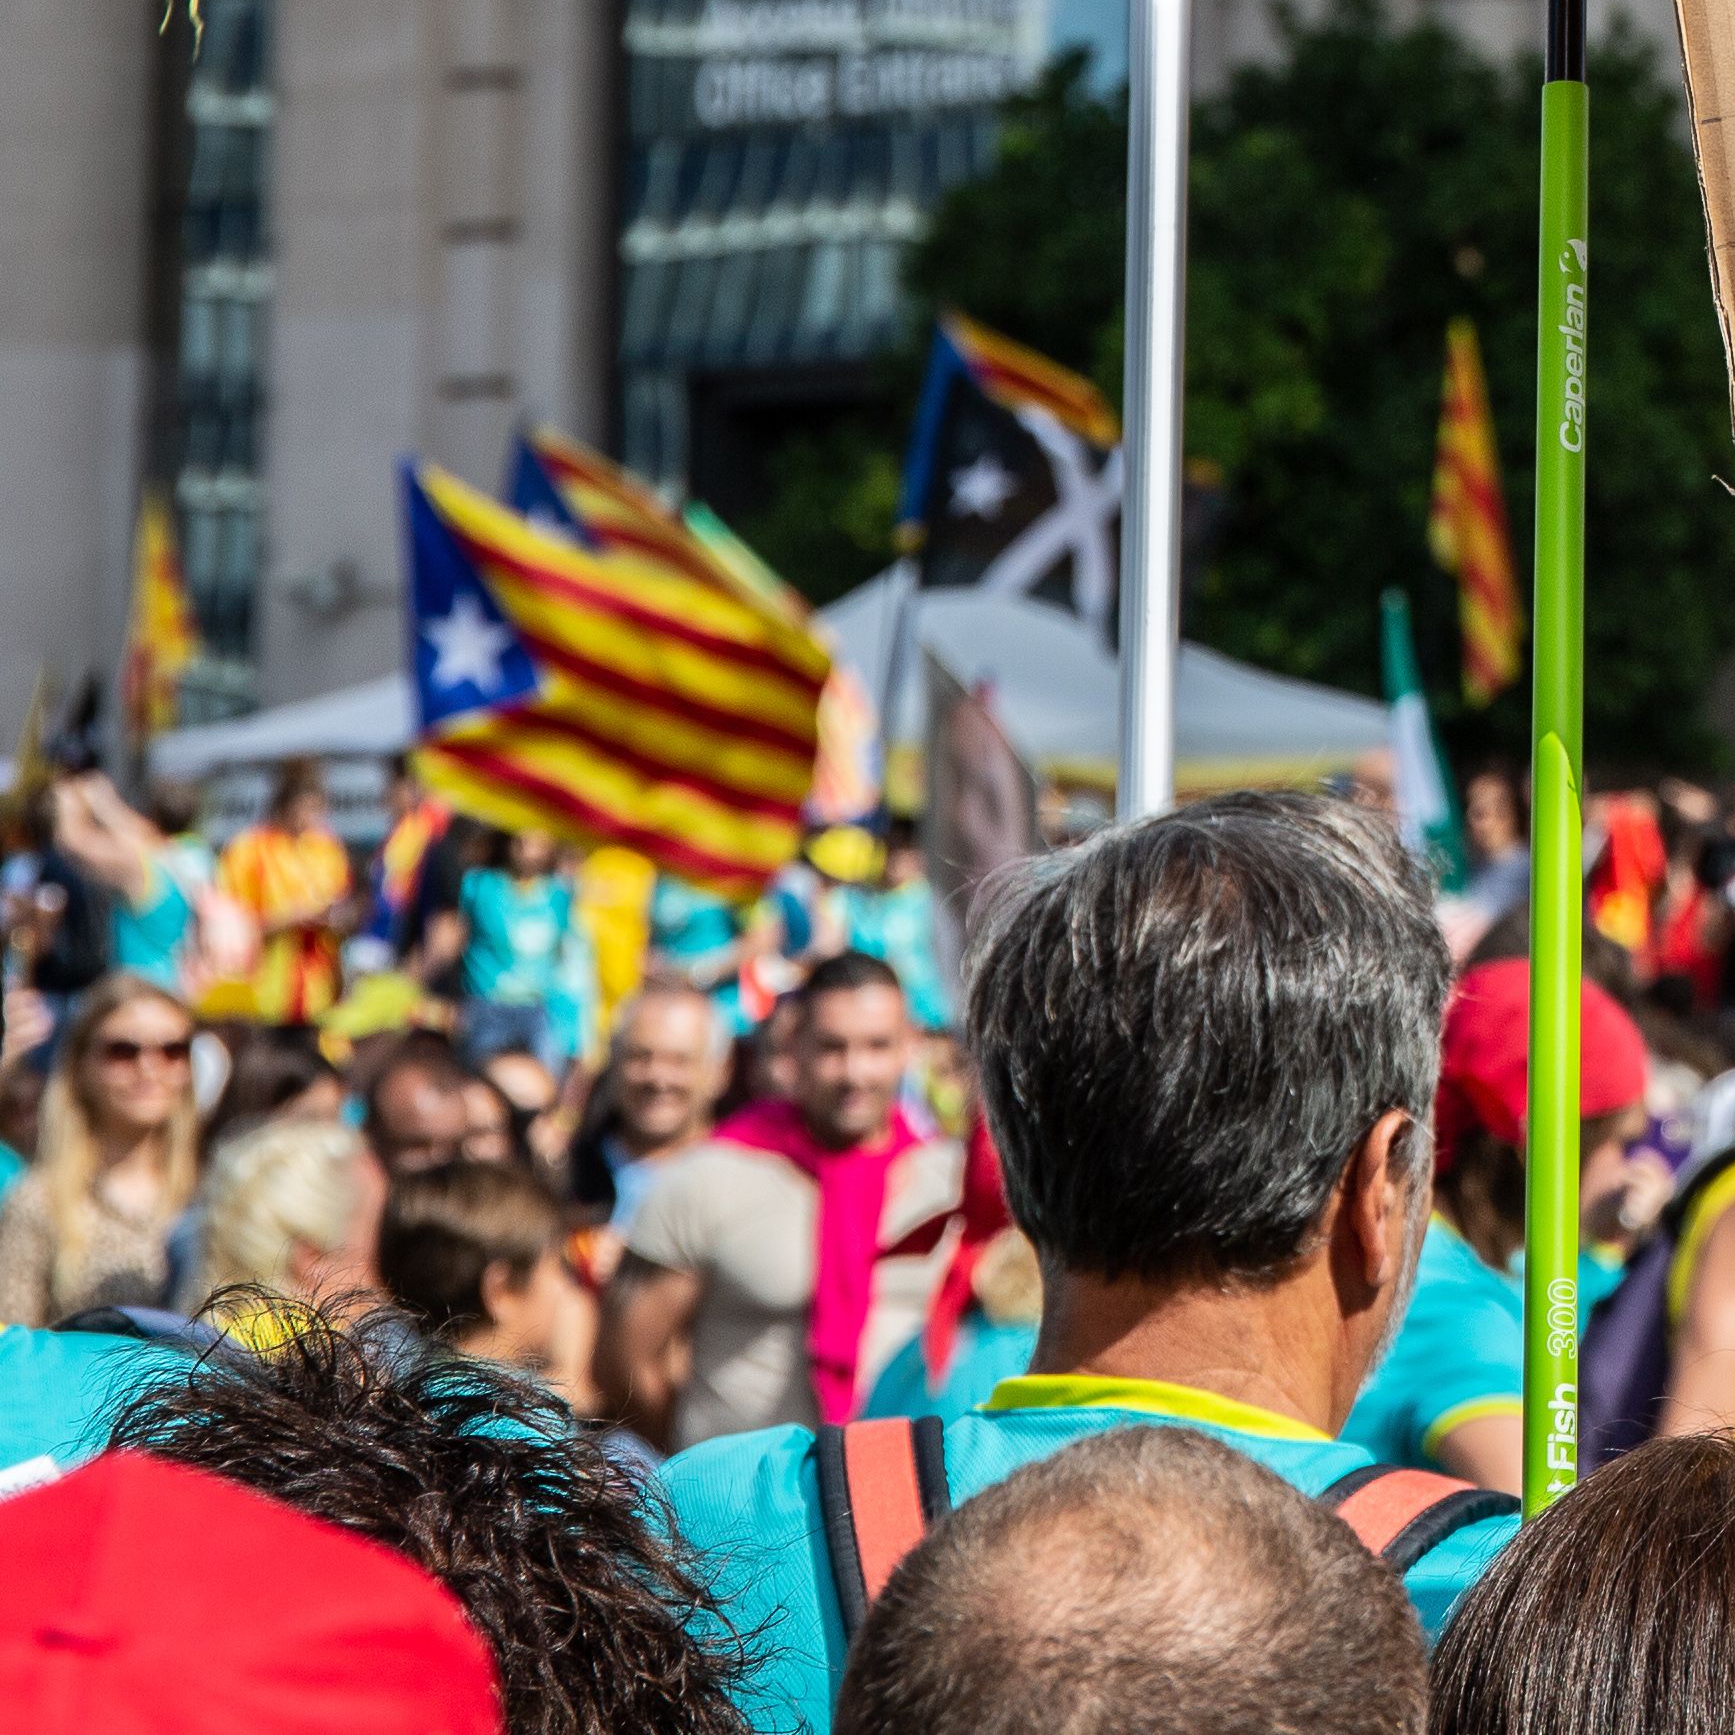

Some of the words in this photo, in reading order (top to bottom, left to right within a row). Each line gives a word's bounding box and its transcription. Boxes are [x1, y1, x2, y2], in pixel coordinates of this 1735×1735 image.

[1558, 282, 1586, 454] Caperlan
[1546, 1277, 1577, 1360] 300
[1546, 1382, 1577, 1472] Fish
